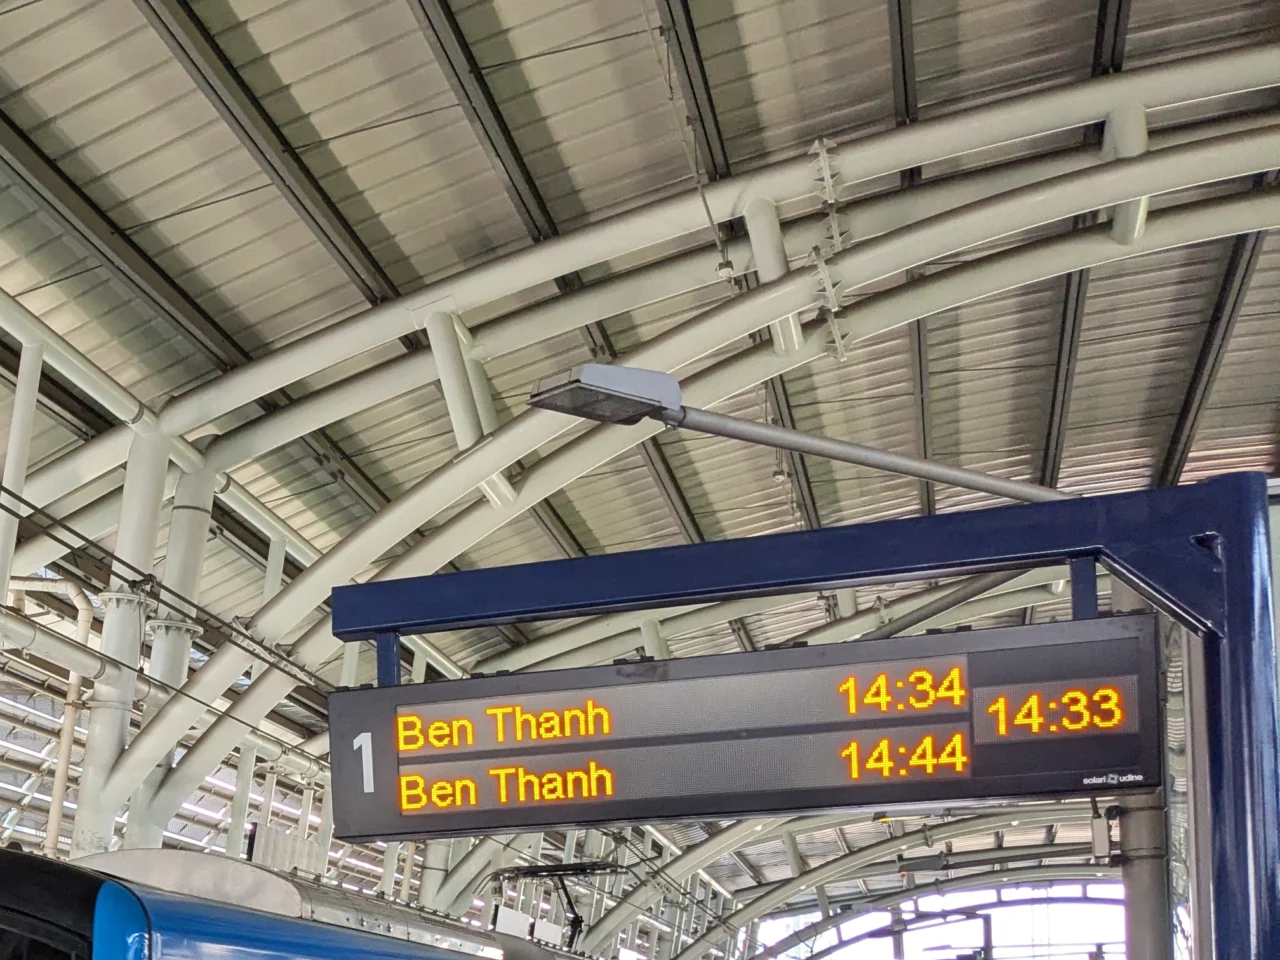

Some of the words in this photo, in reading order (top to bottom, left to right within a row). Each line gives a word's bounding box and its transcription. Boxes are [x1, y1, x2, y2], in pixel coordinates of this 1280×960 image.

[397, 714, 474, 752] Ben
[486, 698, 611, 743] Thanh
[838, 667, 966, 715] 14:34
[987, 687, 1123, 736] 14:33
[352, 732, 375, 794] 1
[399, 775, 477, 811] Ben
[489, 761, 614, 804] Thanh
[841, 733, 968, 779] 14:44
